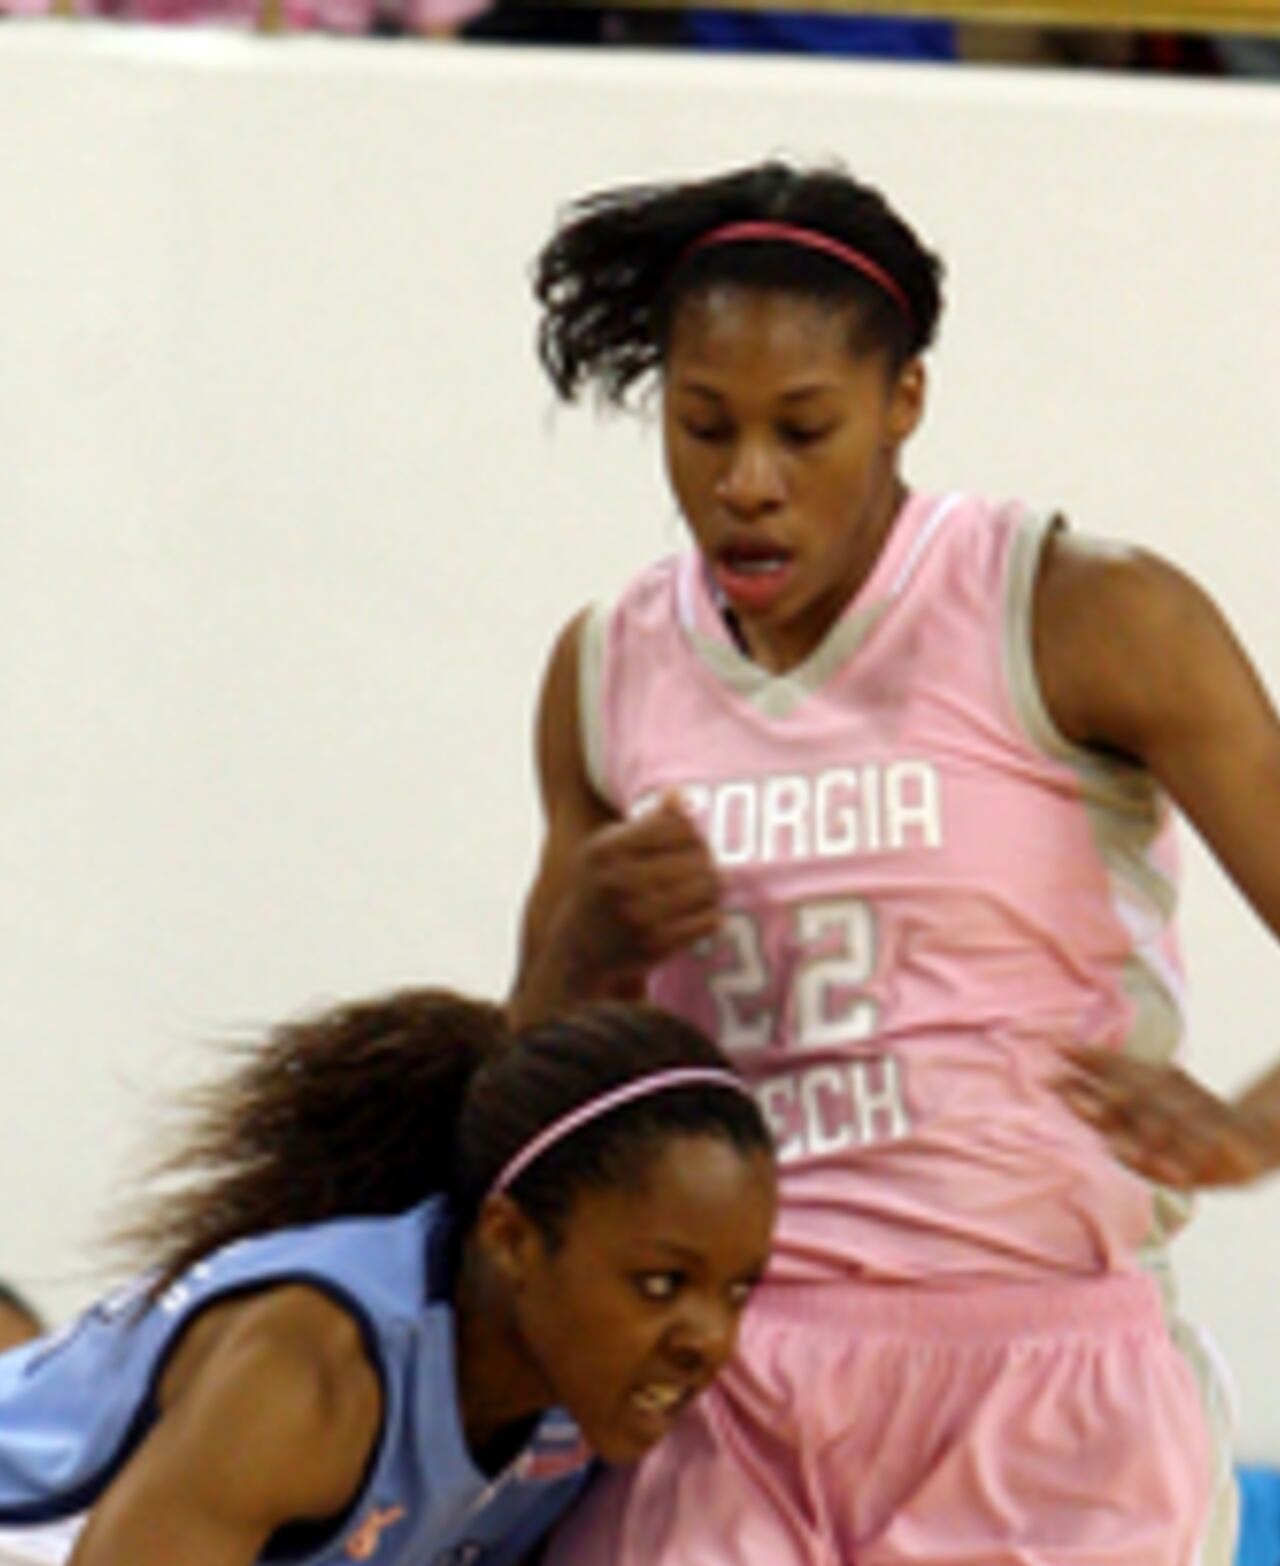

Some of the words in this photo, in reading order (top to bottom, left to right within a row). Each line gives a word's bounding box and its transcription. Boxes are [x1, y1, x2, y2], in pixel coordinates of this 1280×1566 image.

[628, 758, 942, 865] ORGIA
[690, 894, 877, 1050] 22
[752, 1052, 912, 1164] ECH
